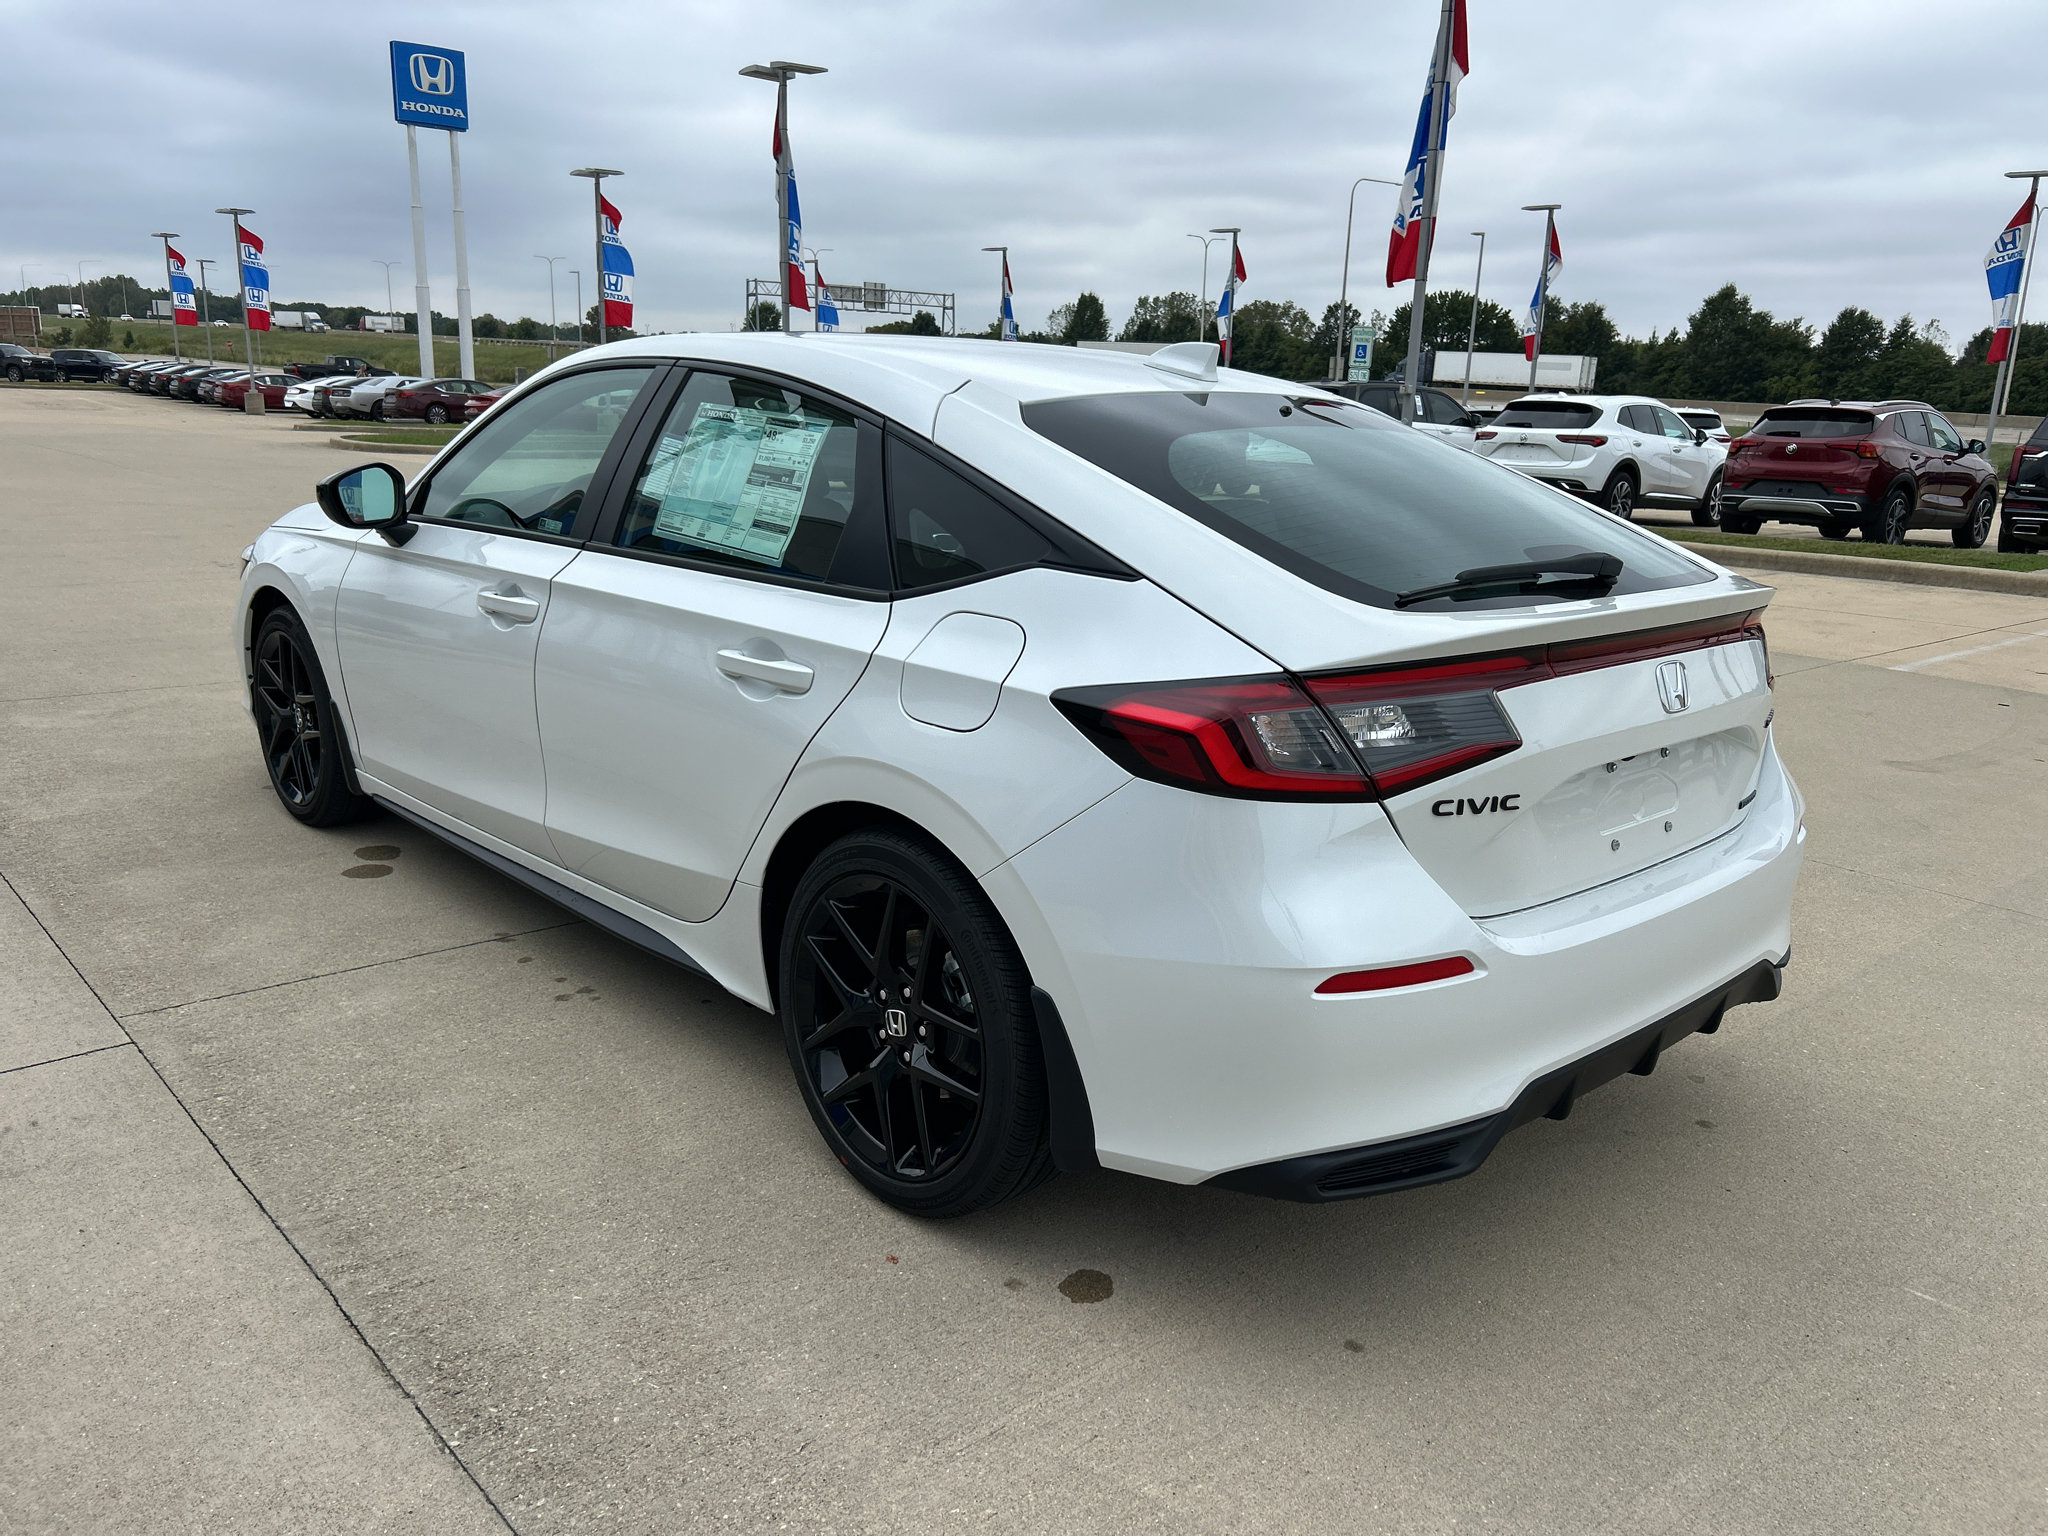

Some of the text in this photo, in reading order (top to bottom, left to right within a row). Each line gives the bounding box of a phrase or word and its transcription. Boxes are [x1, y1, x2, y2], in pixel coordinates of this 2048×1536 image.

[401, 100, 467, 119] HONDA
[604, 292, 630, 302] ONDA
[1432, 794, 1521, 816] CIVIC
